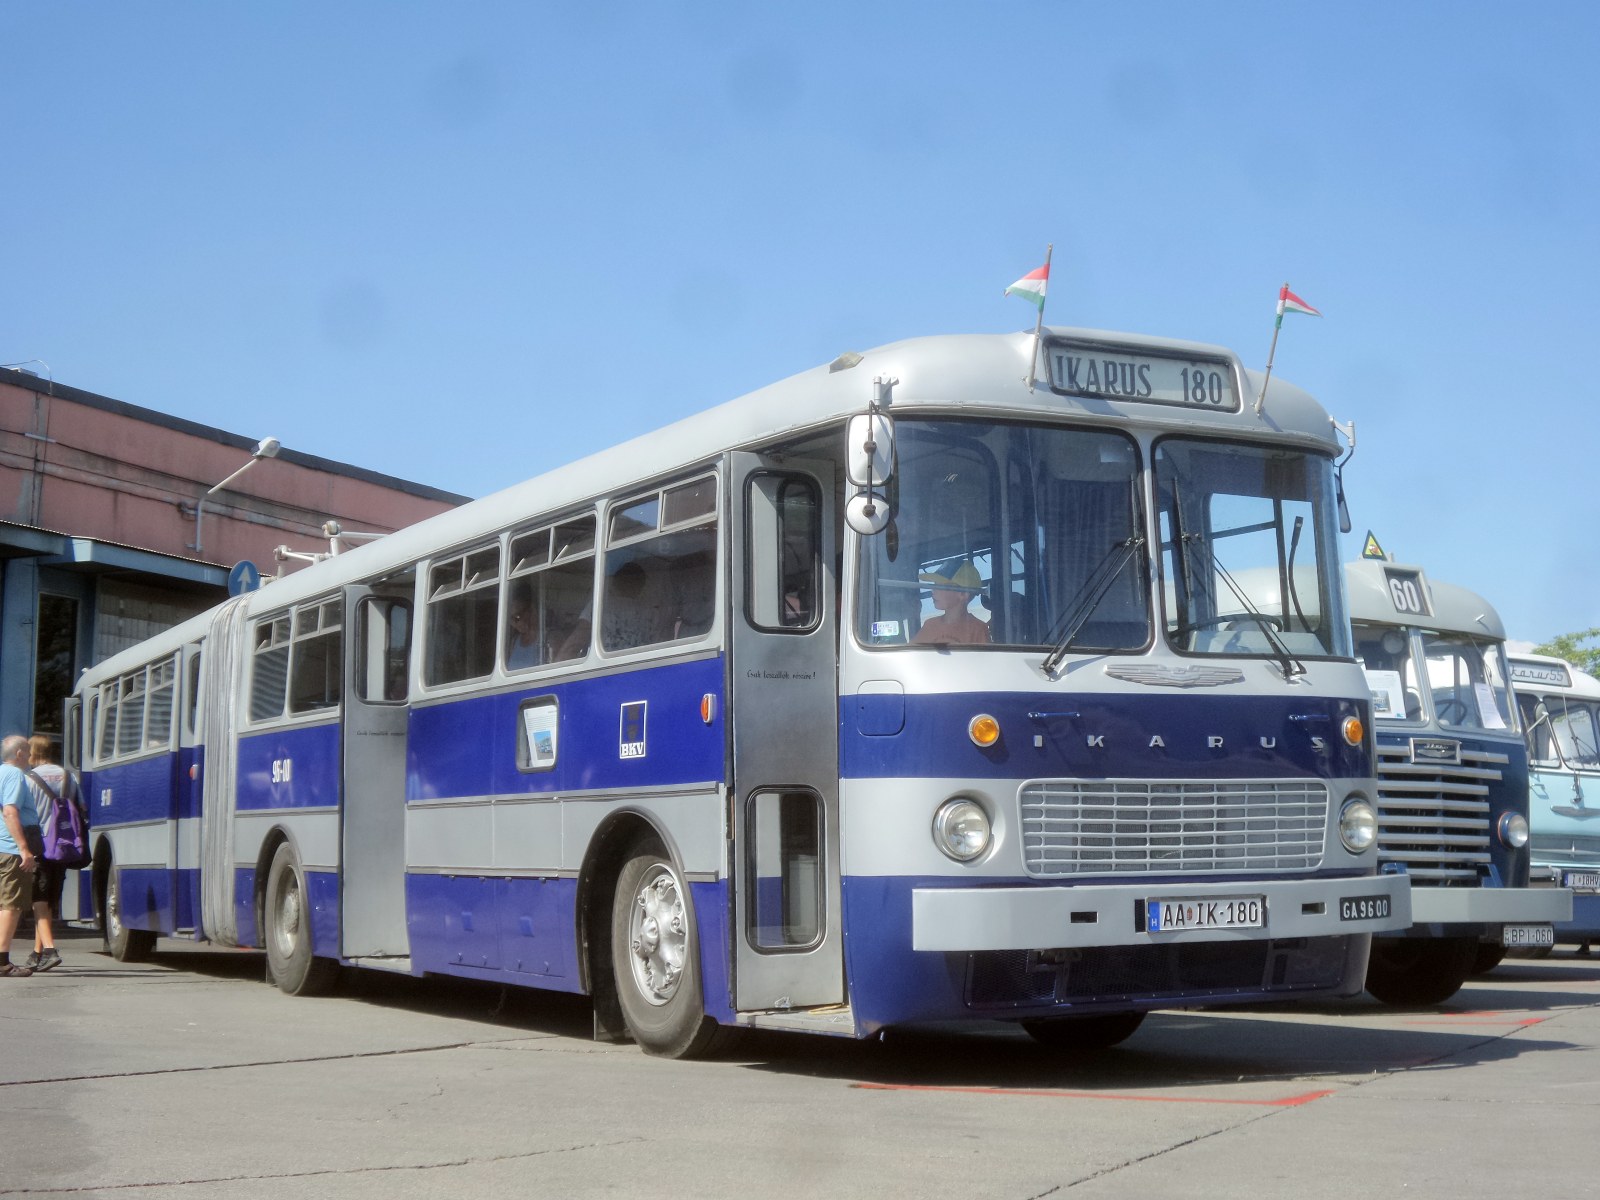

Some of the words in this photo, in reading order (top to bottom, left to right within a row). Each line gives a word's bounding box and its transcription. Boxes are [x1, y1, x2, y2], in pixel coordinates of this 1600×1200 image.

[1056, 355, 1151, 397] IKARUS
[1180, 367, 1223, 405] 180
[1390, 578, 1420, 612] 60
[621, 741, 644, 756] BKV
[1033, 734, 1325, 749] IKARUS
